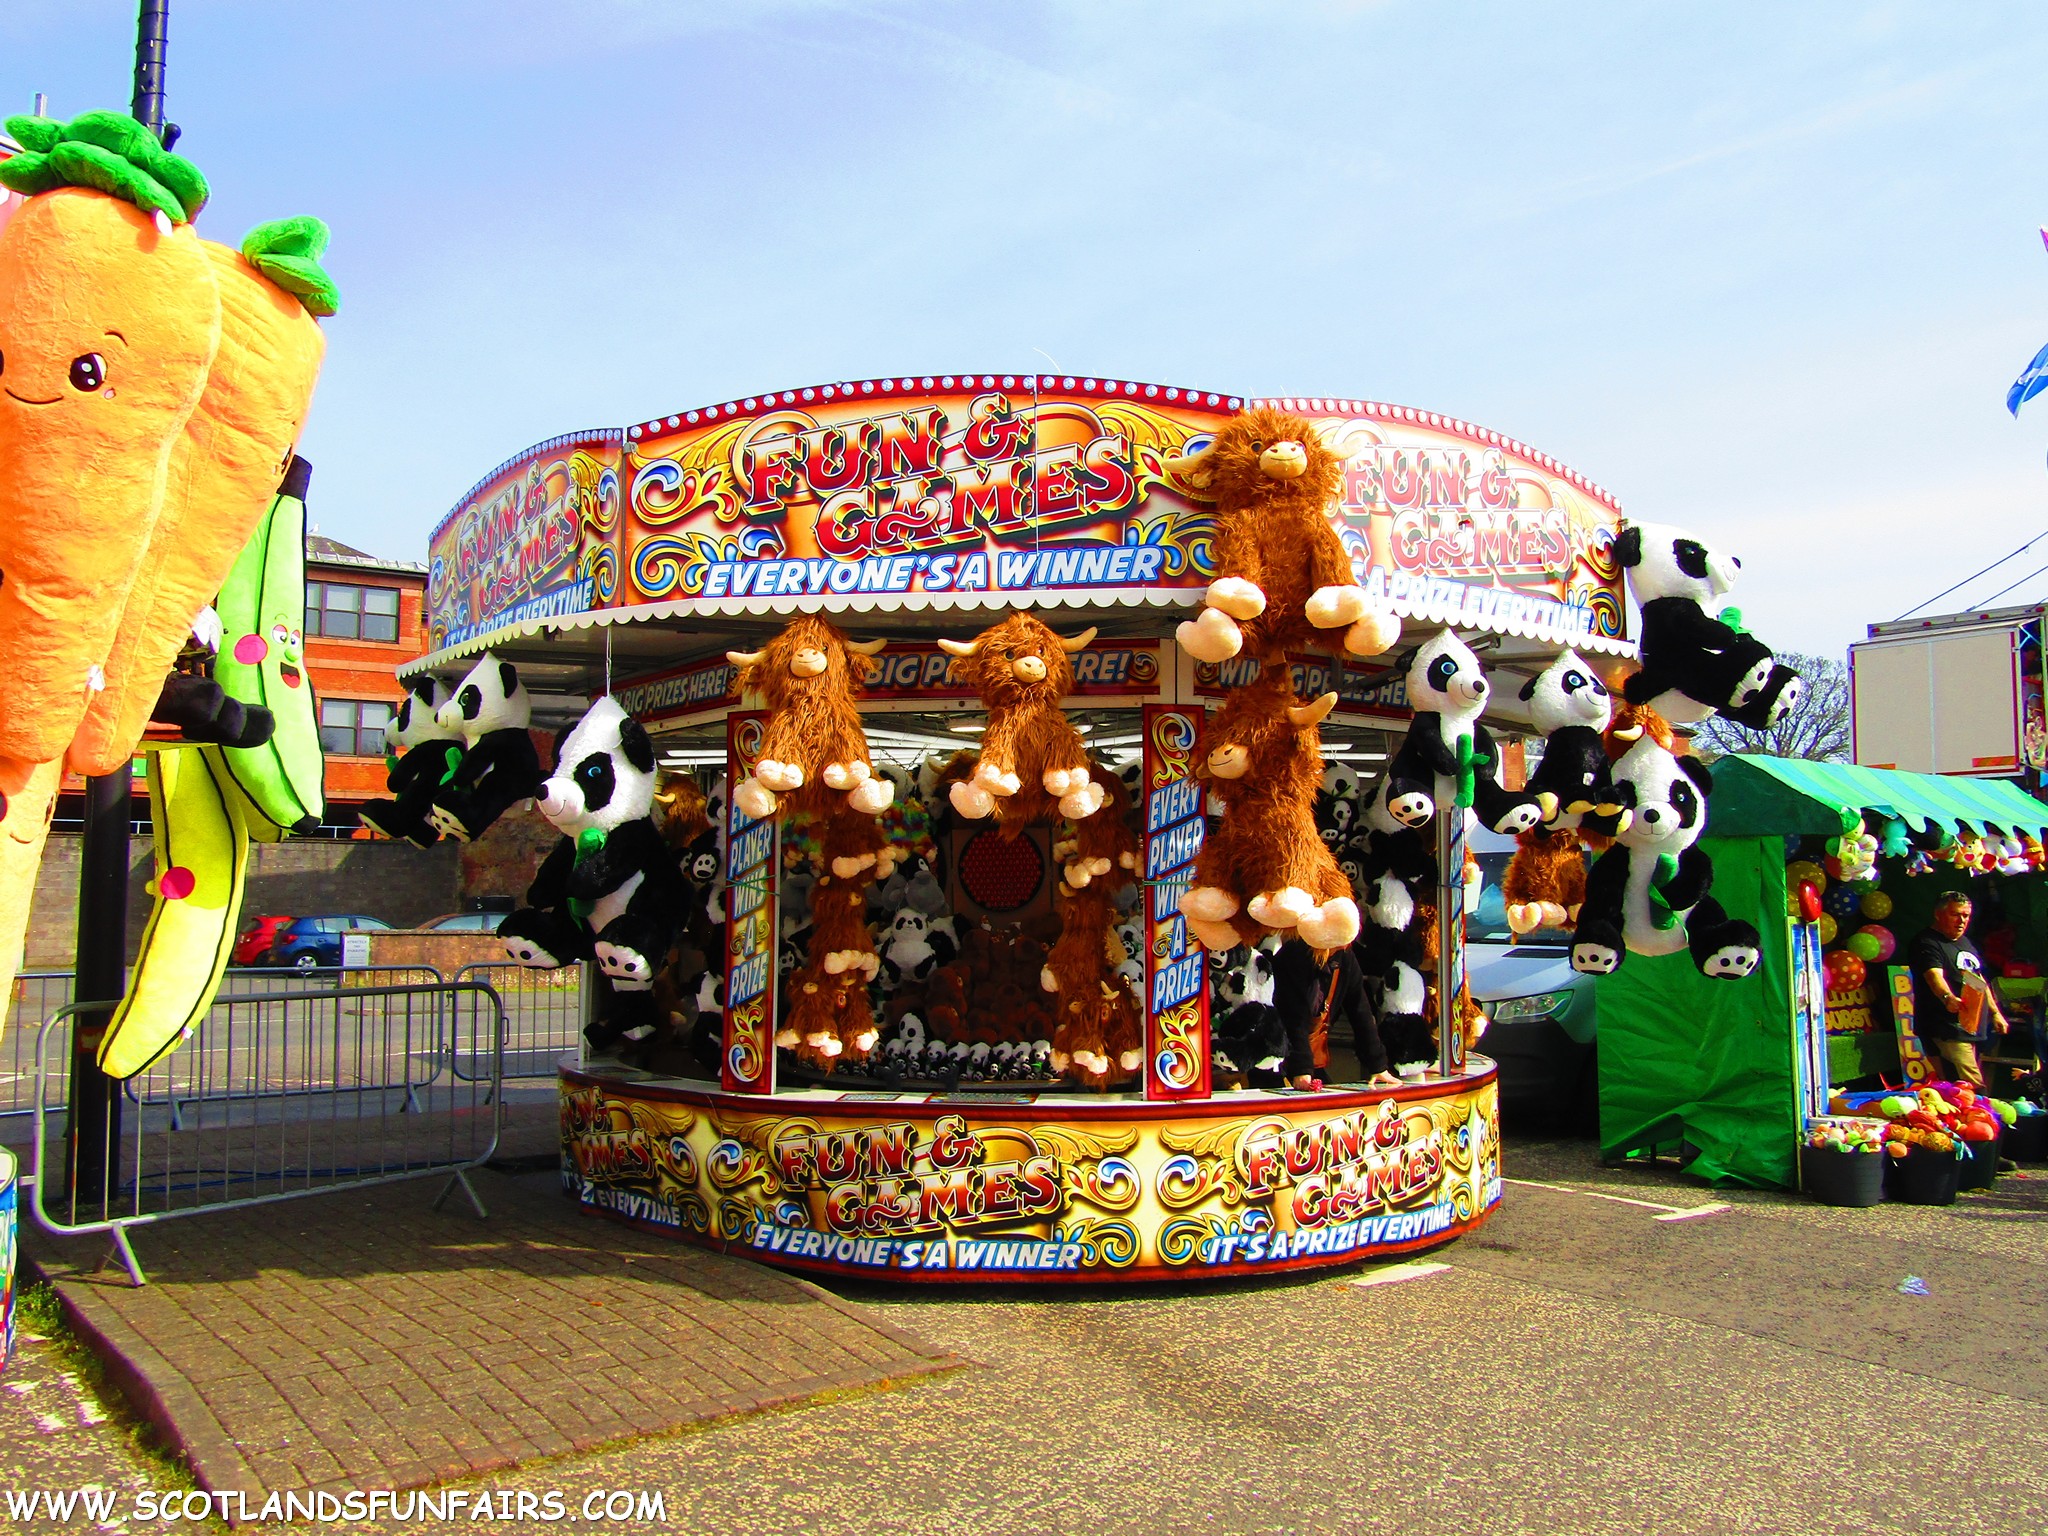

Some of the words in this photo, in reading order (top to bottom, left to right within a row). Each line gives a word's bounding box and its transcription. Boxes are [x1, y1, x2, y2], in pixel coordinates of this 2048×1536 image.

[745, 406, 944, 515] FUN
[961, 391, 1032, 463] &
[1343, 444, 1468, 516] FUN
[1480, 447, 1519, 509] &
[458, 481, 520, 589] FUN
[525, 460, 548, 523] &
[814, 432, 1136, 562] GAMES
[479, 481, 582, 618] GAMES
[1388, 507, 1575, 577] GAMES
[514, 580, 593, 623] EVERYTIME
[703, 553, 961, 597] EVERYONE'S
[955, 554, 986, 588] A
[1000, 548, 1163, 587] WINNER
[1389, 570, 1466, 610] PRIZE
[1465, 586, 1593, 632] EVERYTIME
[624, 688, 645, 713] BIG
[645, 676, 688, 711] PRIZES
[688, 667, 729, 700] HERE!
[864, 657, 919, 684] BIG
[1149, 779, 1201, 832] EVERY
[730, 822, 772, 877] PLAYER
[1149, 818, 1203, 877] PLAYER
[734, 865, 768, 918] WINS
[745, 915, 756, 955] A
[1170, 916, 1185, 957] A
[730, 953, 769, 1006] PRIZE
[1154, 954, 1202, 1011] PRIZE
[775, 1122, 916, 1191] FUN
[929, 1115, 983, 1168] &
[1243, 1110, 1367, 1199] FUN
[1374, 1098, 1410, 1150] &
[825, 1155, 1062, 1239] GAMES
[1290, 1129, 1446, 1231] GAMES
[753, 1223, 922, 1268] EVERYONE'S
[926, 1241, 948, 1267] A
[956, 1240, 1081, 1271] WINNER
[1209, 1232, 1268, 1264] IT'S
[1271, 1232, 1290, 1260] A
[1294, 1223, 1358, 1257] PRIZE
[1358, 1205, 1453, 1245] EVERYTIME
